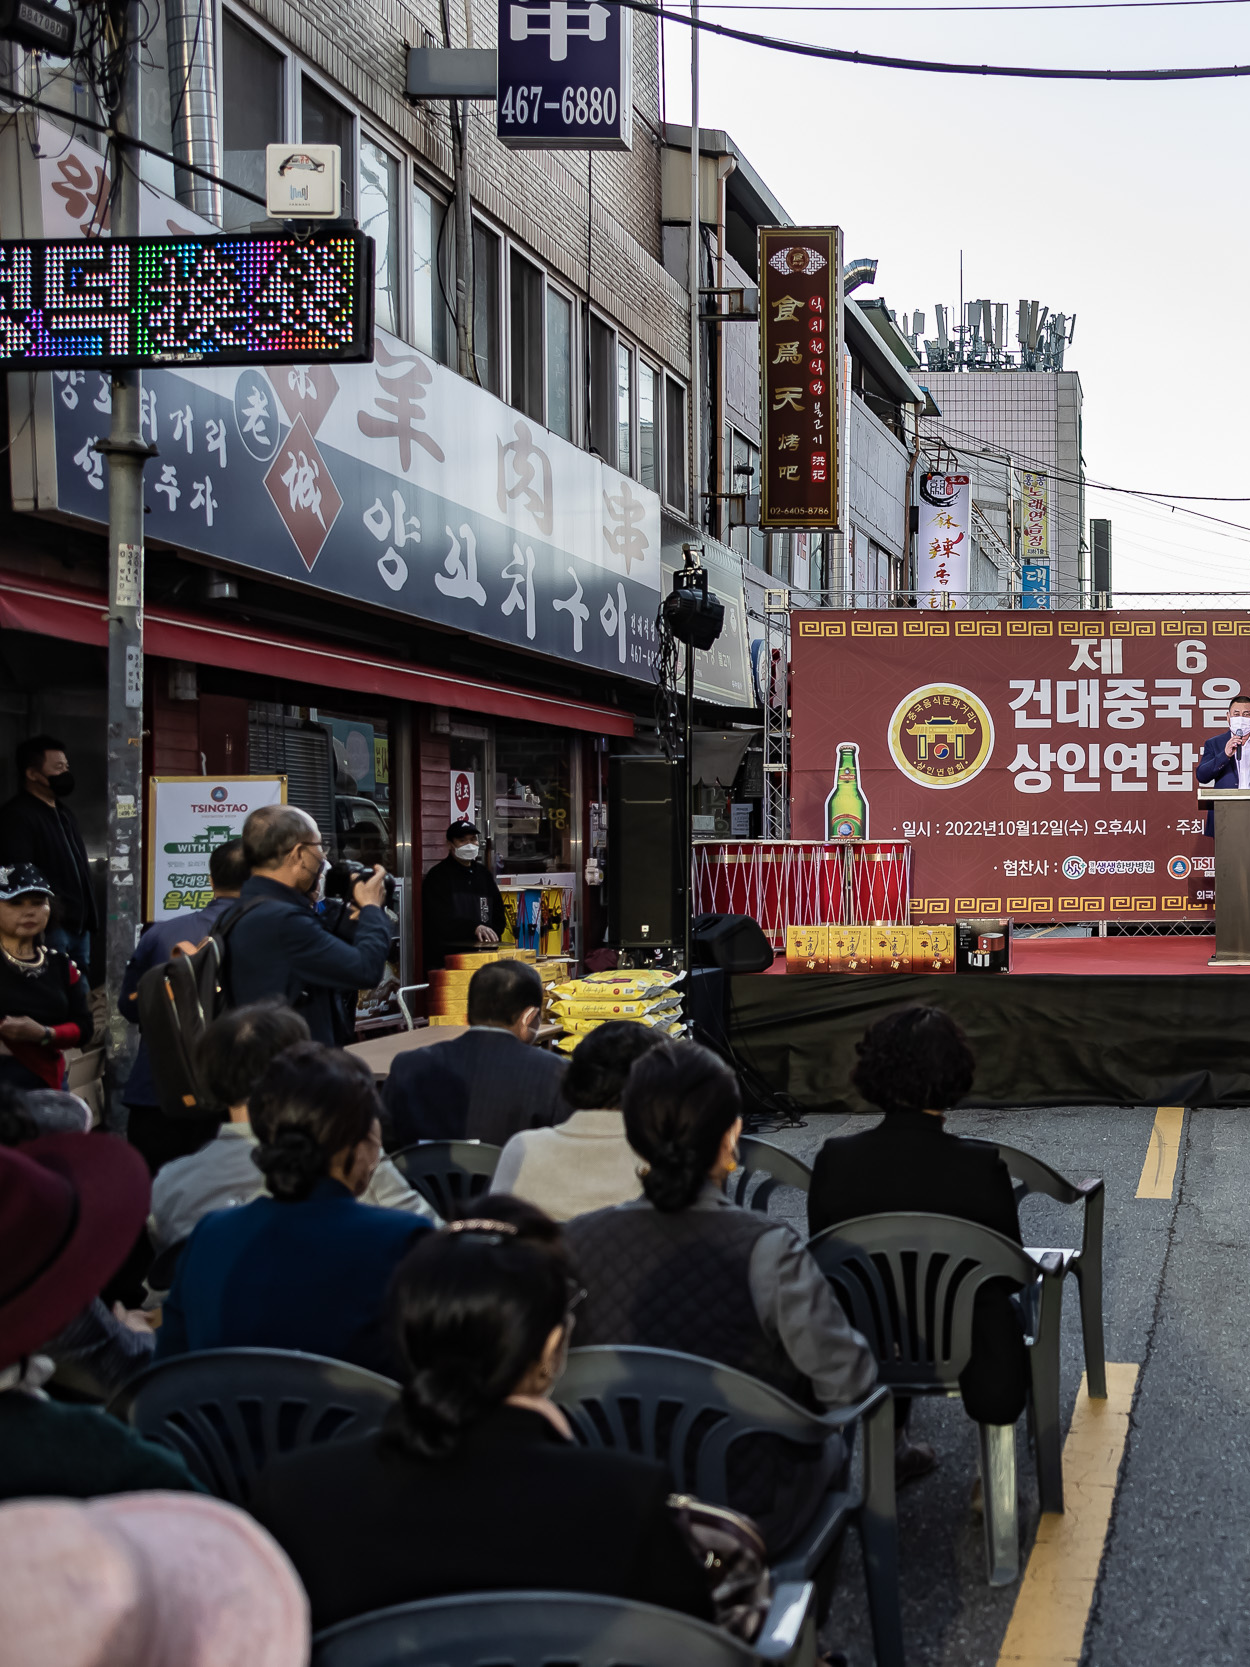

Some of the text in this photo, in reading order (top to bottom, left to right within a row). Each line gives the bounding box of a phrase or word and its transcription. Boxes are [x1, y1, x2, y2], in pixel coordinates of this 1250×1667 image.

[502, 86, 617, 125] 467-6880
[770, 507, 829, 515] 02-6405-8786
[1027, 487, 1046, 547] 노래연습장
[1069, 638, 1123, 674] 제
[1176, 639, 1207, 674] 6
[1007, 741, 1200, 793] 상인연합
[191, 803, 248, 813] TSINGTAO
[902, 821, 931, 837] 일시
[945, 819, 1088, 837] 2022년10월12일(수)
[1094, 820, 1147, 836] 오후4시
[178, 844, 206, 852] WITH
[1003, 859, 1049, 877] 협찬사
[1096, 860, 1155, 874] 생생한방병원
